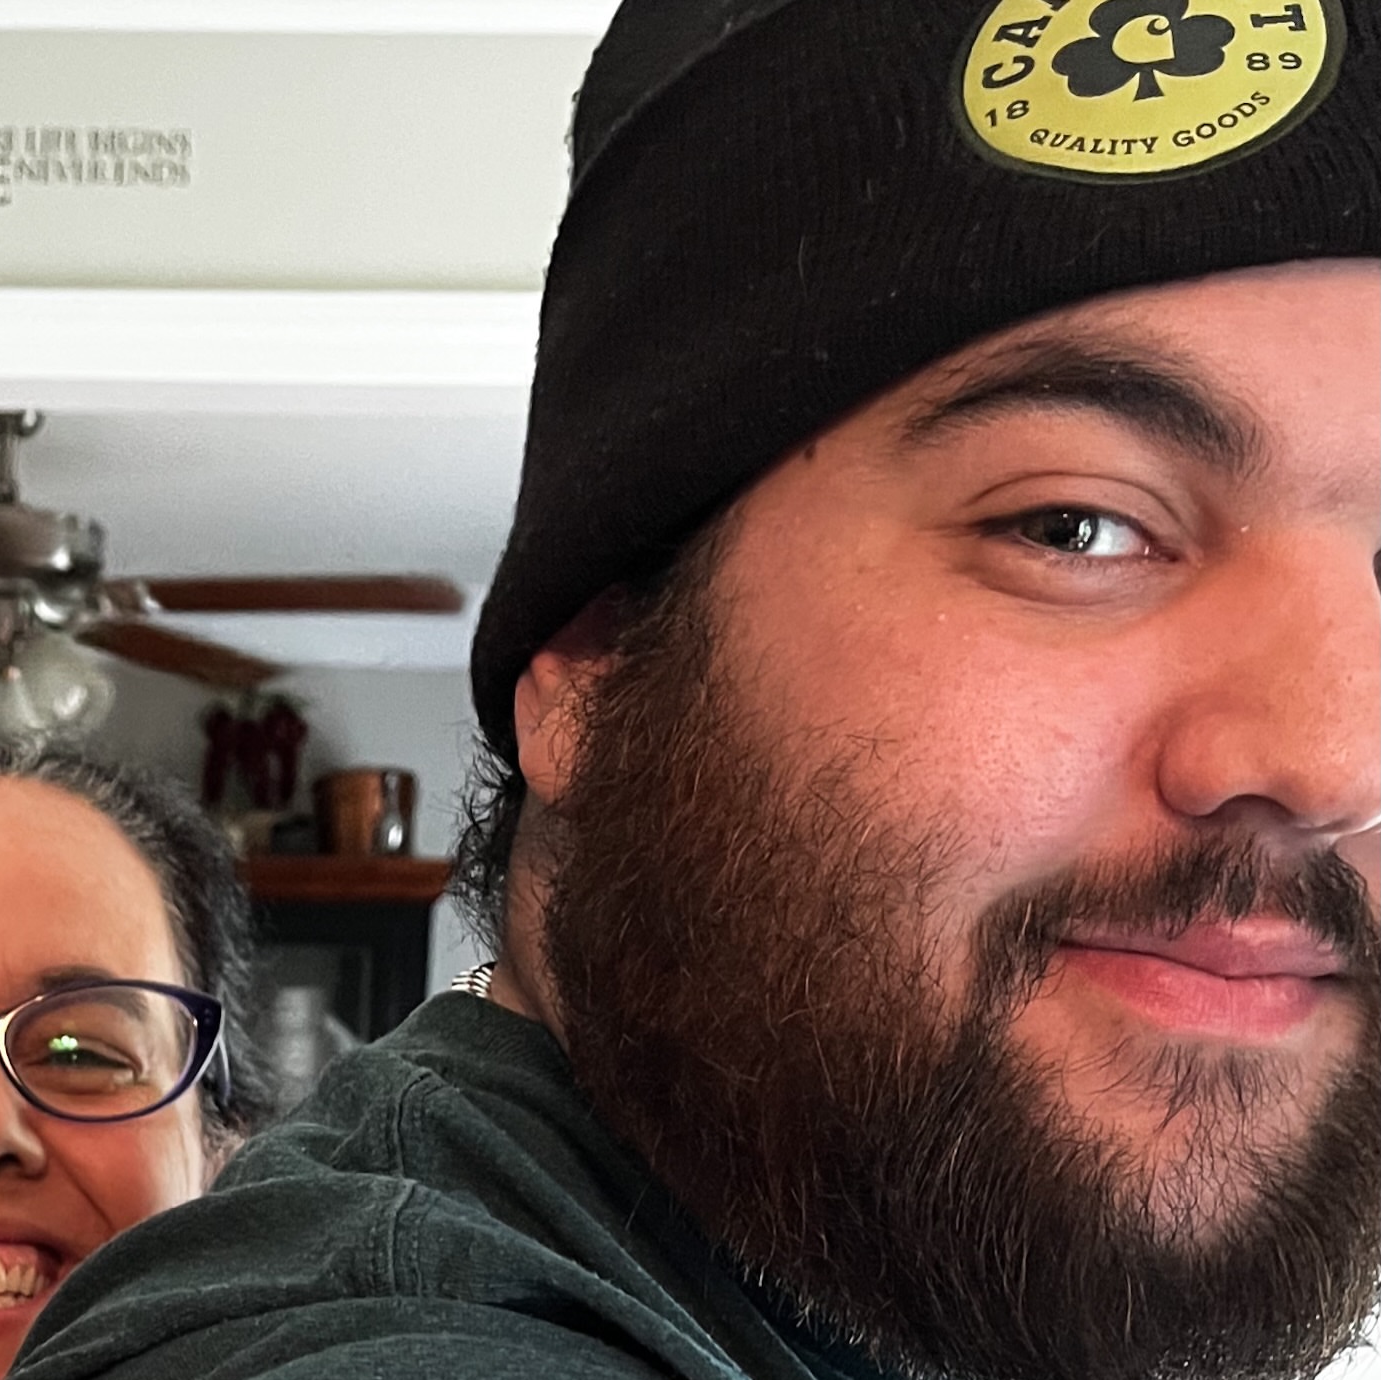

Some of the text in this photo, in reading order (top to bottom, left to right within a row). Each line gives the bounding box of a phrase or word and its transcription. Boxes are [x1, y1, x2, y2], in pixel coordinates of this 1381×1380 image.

[985, 53, 1303, 129] 18 89
[1029, 91, 1271, 155] QUALITY GOODS
